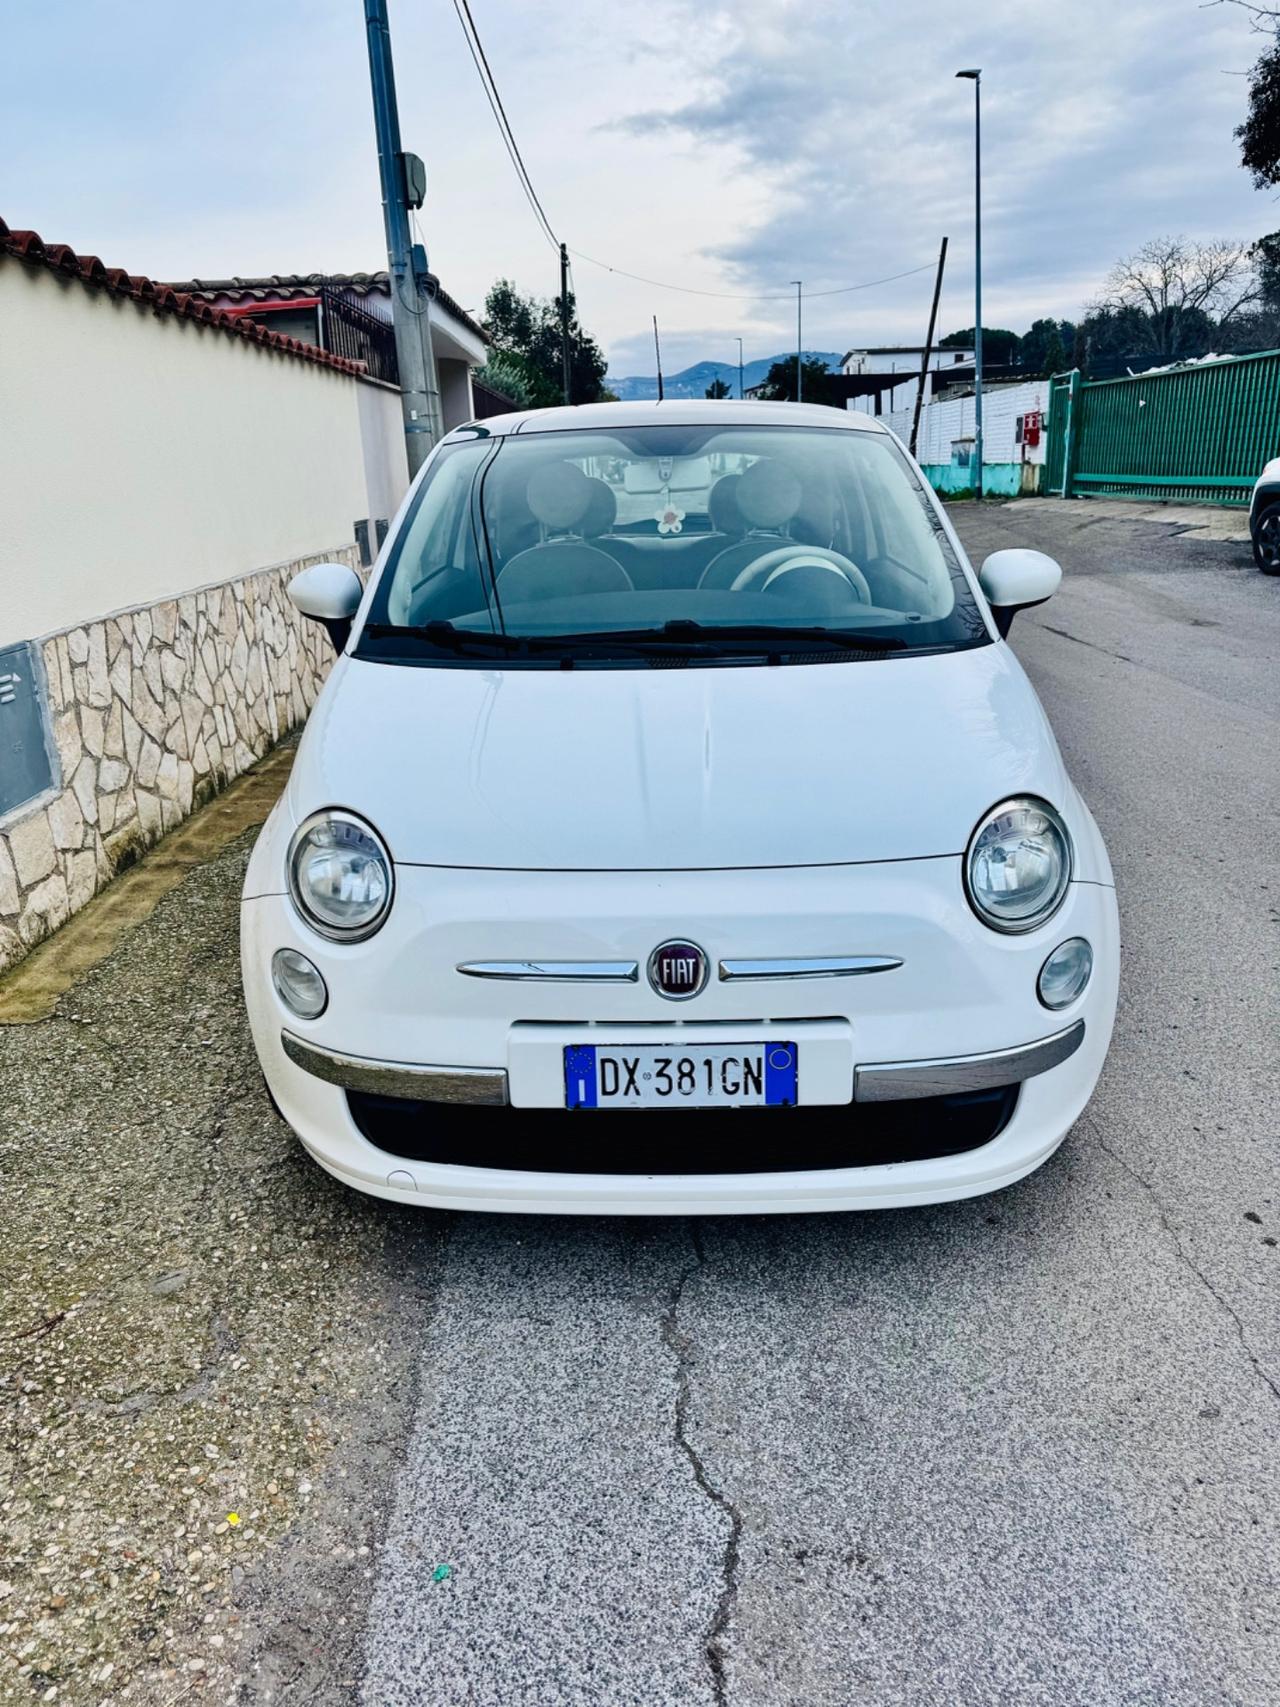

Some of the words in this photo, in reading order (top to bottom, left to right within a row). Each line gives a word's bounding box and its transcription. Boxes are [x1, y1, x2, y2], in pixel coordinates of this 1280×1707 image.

[662, 958, 696, 984] FIAT
[600, 1057, 641, 1096] DX
[653, 1057, 762, 1097] 381GN
